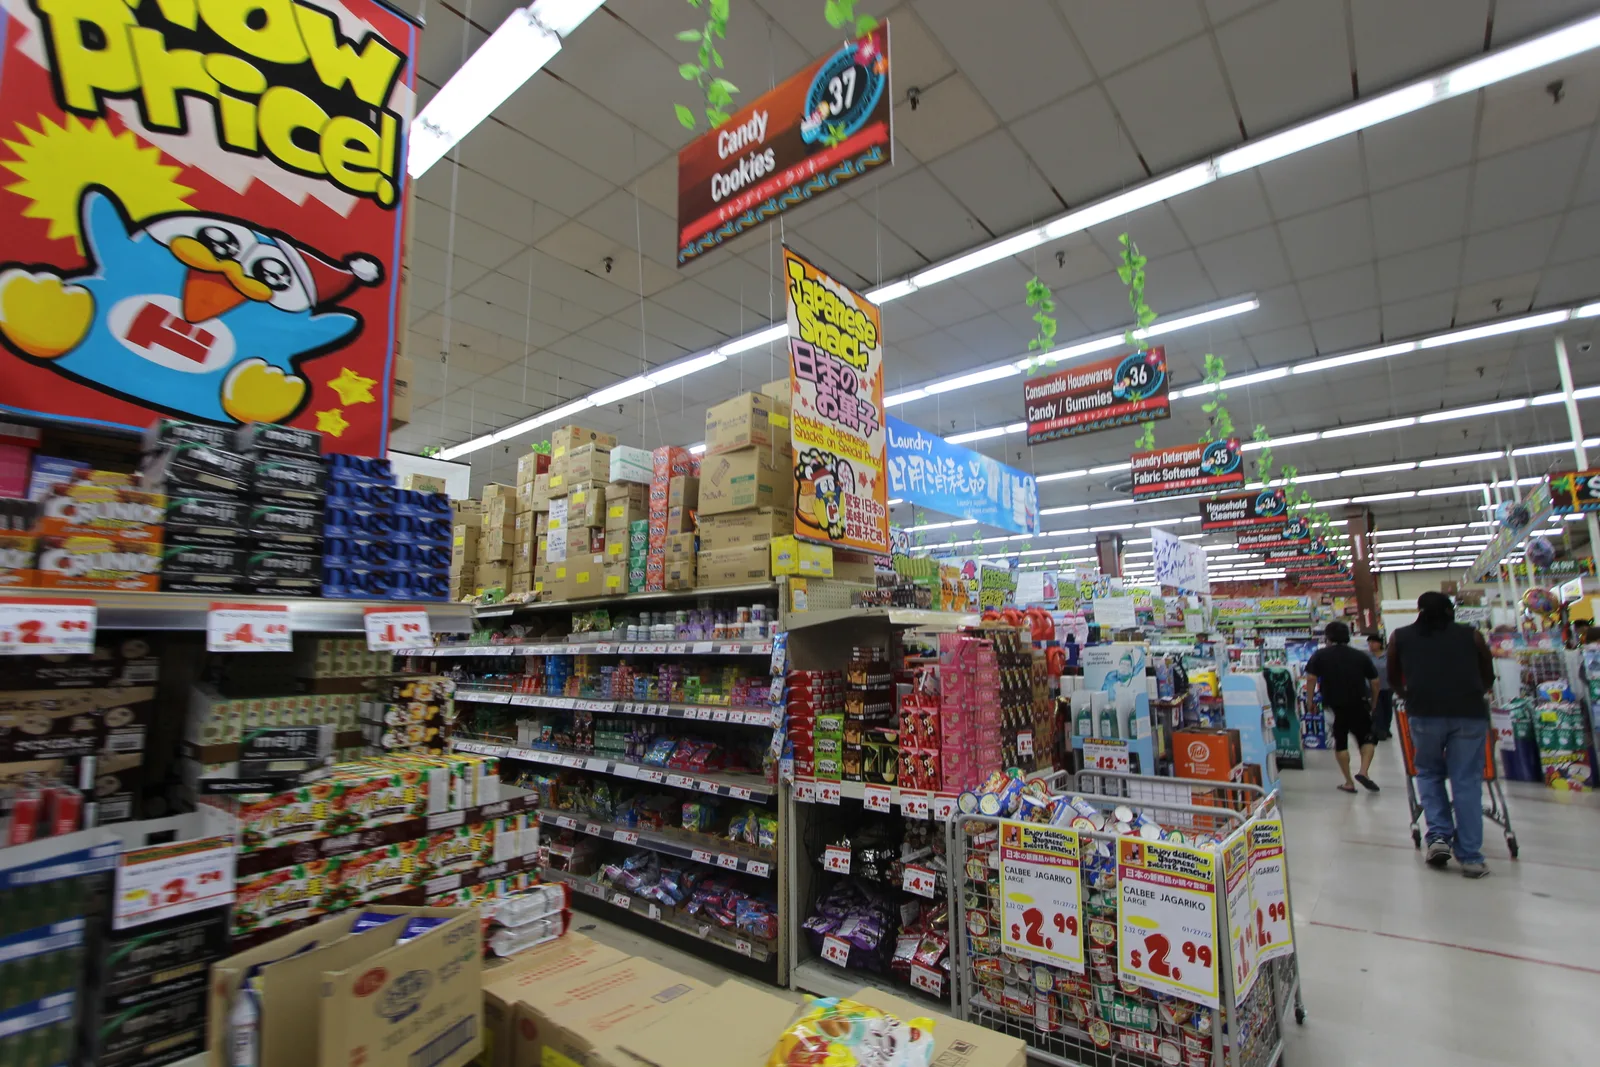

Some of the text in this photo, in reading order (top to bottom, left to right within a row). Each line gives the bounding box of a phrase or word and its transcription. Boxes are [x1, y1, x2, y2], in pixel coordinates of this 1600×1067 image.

[118, 0, 404, 108] ow
[36, 0, 402, 210] price!
[828, 66, 857, 116] 37
[717, 109, 769, 160] Candy
[711, 147, 776, 202] Cookies
[787, 258, 877, 350] Japanese
[796, 302, 870, 373] Snack
[790, 337, 859, 394] 日本の
[1025, 363, 1148, 401] Consumable Housewares 36
[815, 381, 880, 438] お菓子
[1028, 401, 1056, 422] Candy
[1065, 389, 1113, 413] Gummies
[794, 409, 869, 450] Popular Japanese
[794, 426, 825, 448] Snacks
[827, 437, 837, 451] on
[888, 426, 933, 454] Laundry
[1131, 447, 1228, 470] Laundry Detergent 35
[1133, 470, 1161, 485] Fabric
[1162, 465, 1200, 481] Softener
[1206, 498, 1248, 513] Household
[1210, 509, 1245, 521] Cleaners
[1147, 845, 1209, 866] Enjoy delicious
[1004, 865, 1073, 885] CALBEE JAGARIKO
[1004, 875, 1025, 884] LARGE
[1123, 885, 1206, 911] CALBEE JAGARIKO
[1123, 895, 1147, 907] LARGE
[1011, 906, 1078, 951] $2.99
[1130, 932, 1213, 982] $2.99
